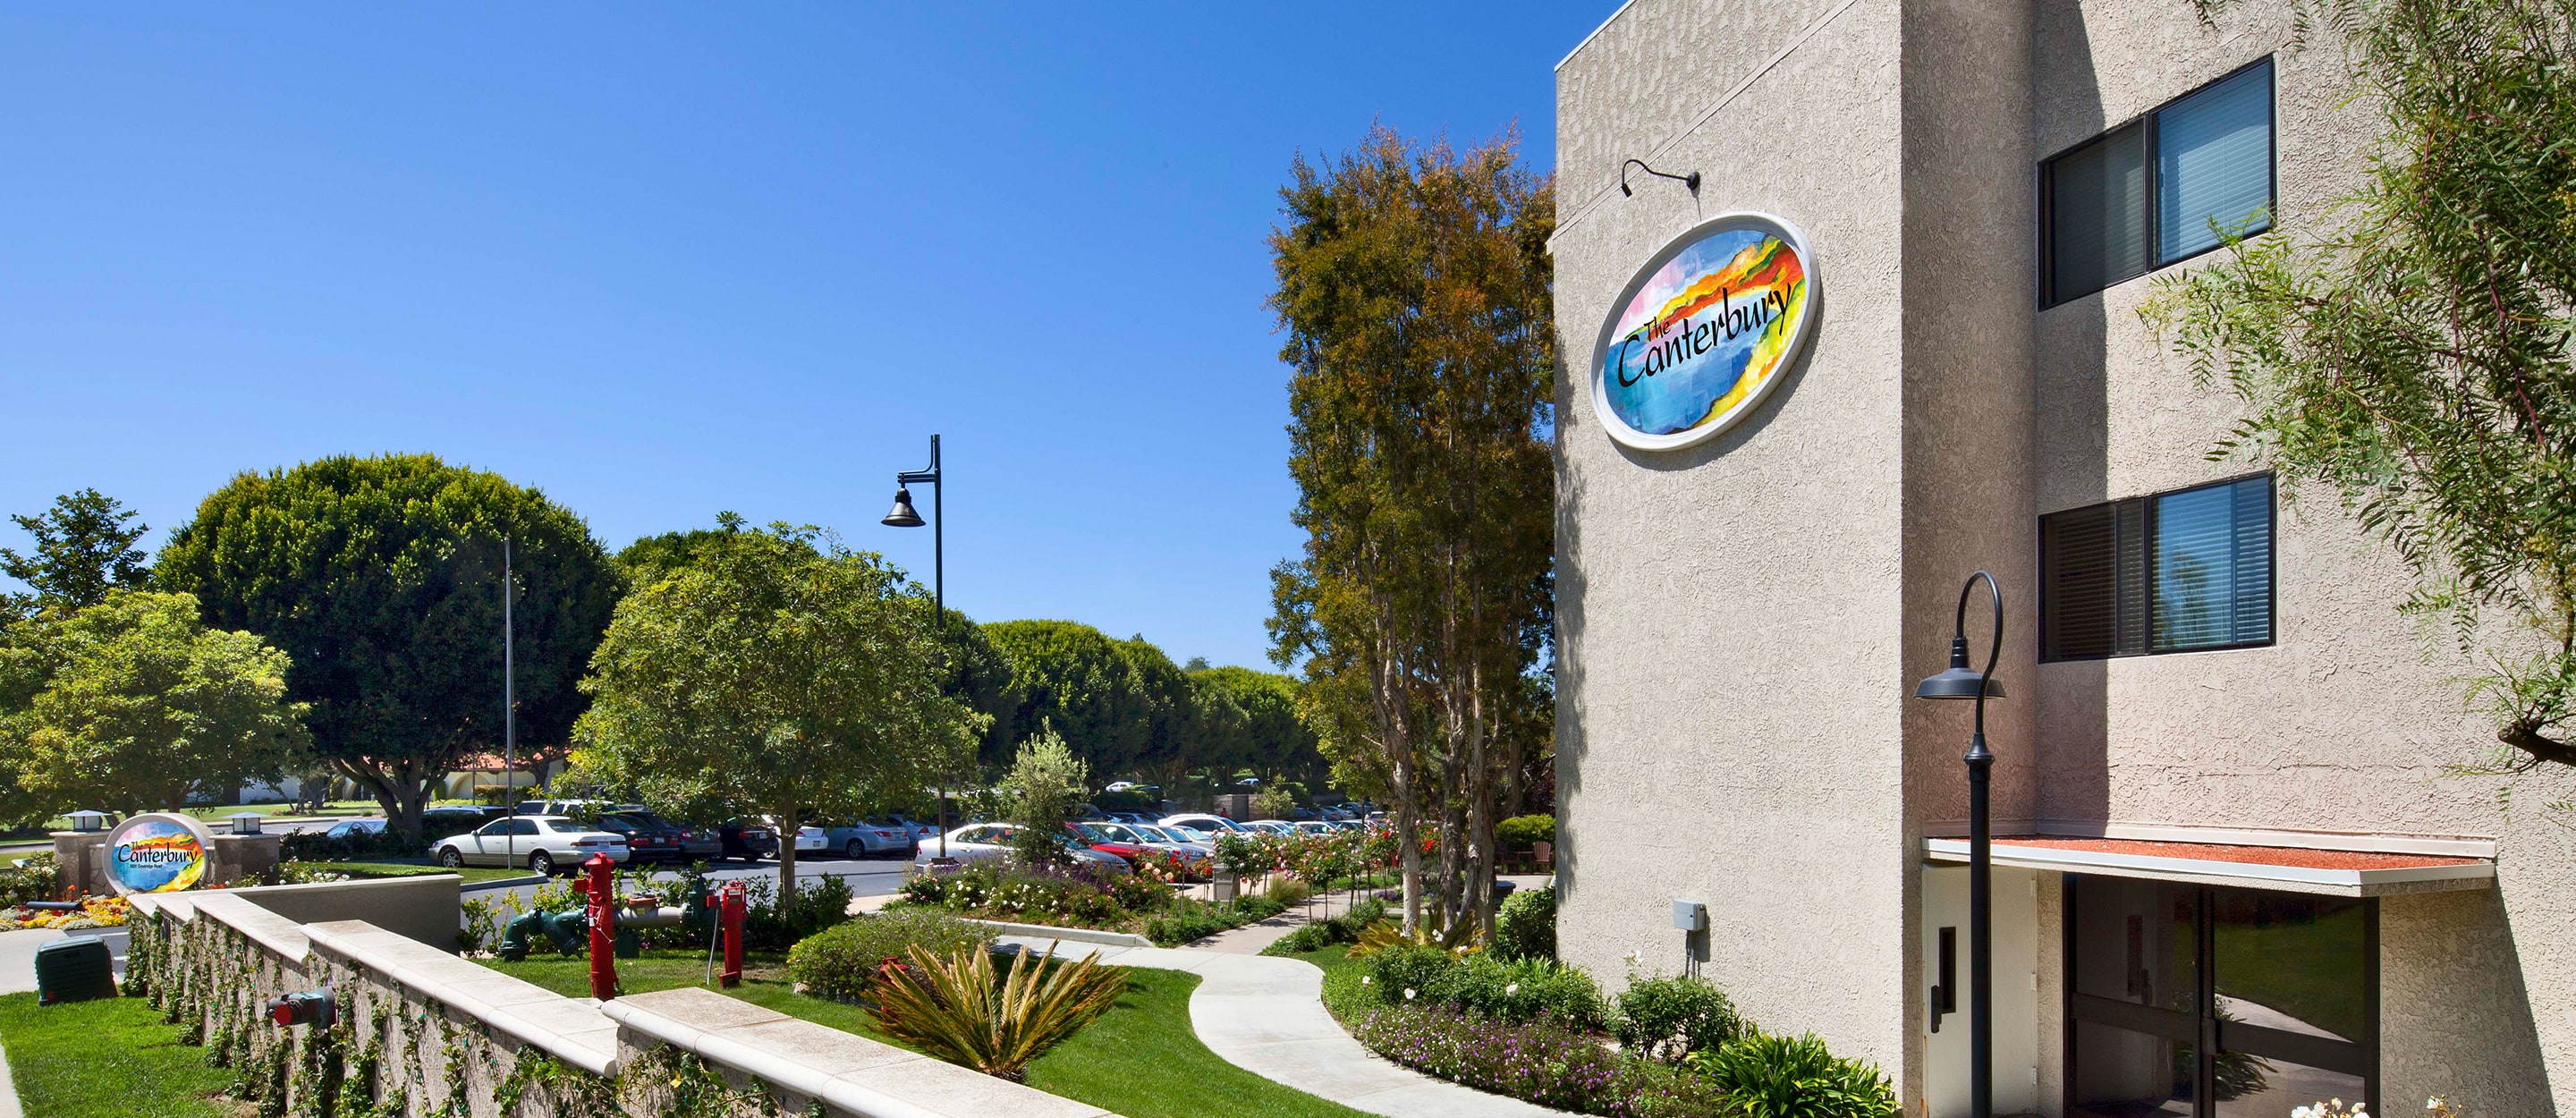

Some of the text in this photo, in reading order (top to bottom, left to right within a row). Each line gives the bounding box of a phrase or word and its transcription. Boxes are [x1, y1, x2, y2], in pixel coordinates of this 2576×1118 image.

[1617, 282, 1792, 388] Canterbury
[1643, 316, 1671, 342] The
[118, 842, 198, 868] Canterbury
[131, 841, 143, 850] The
